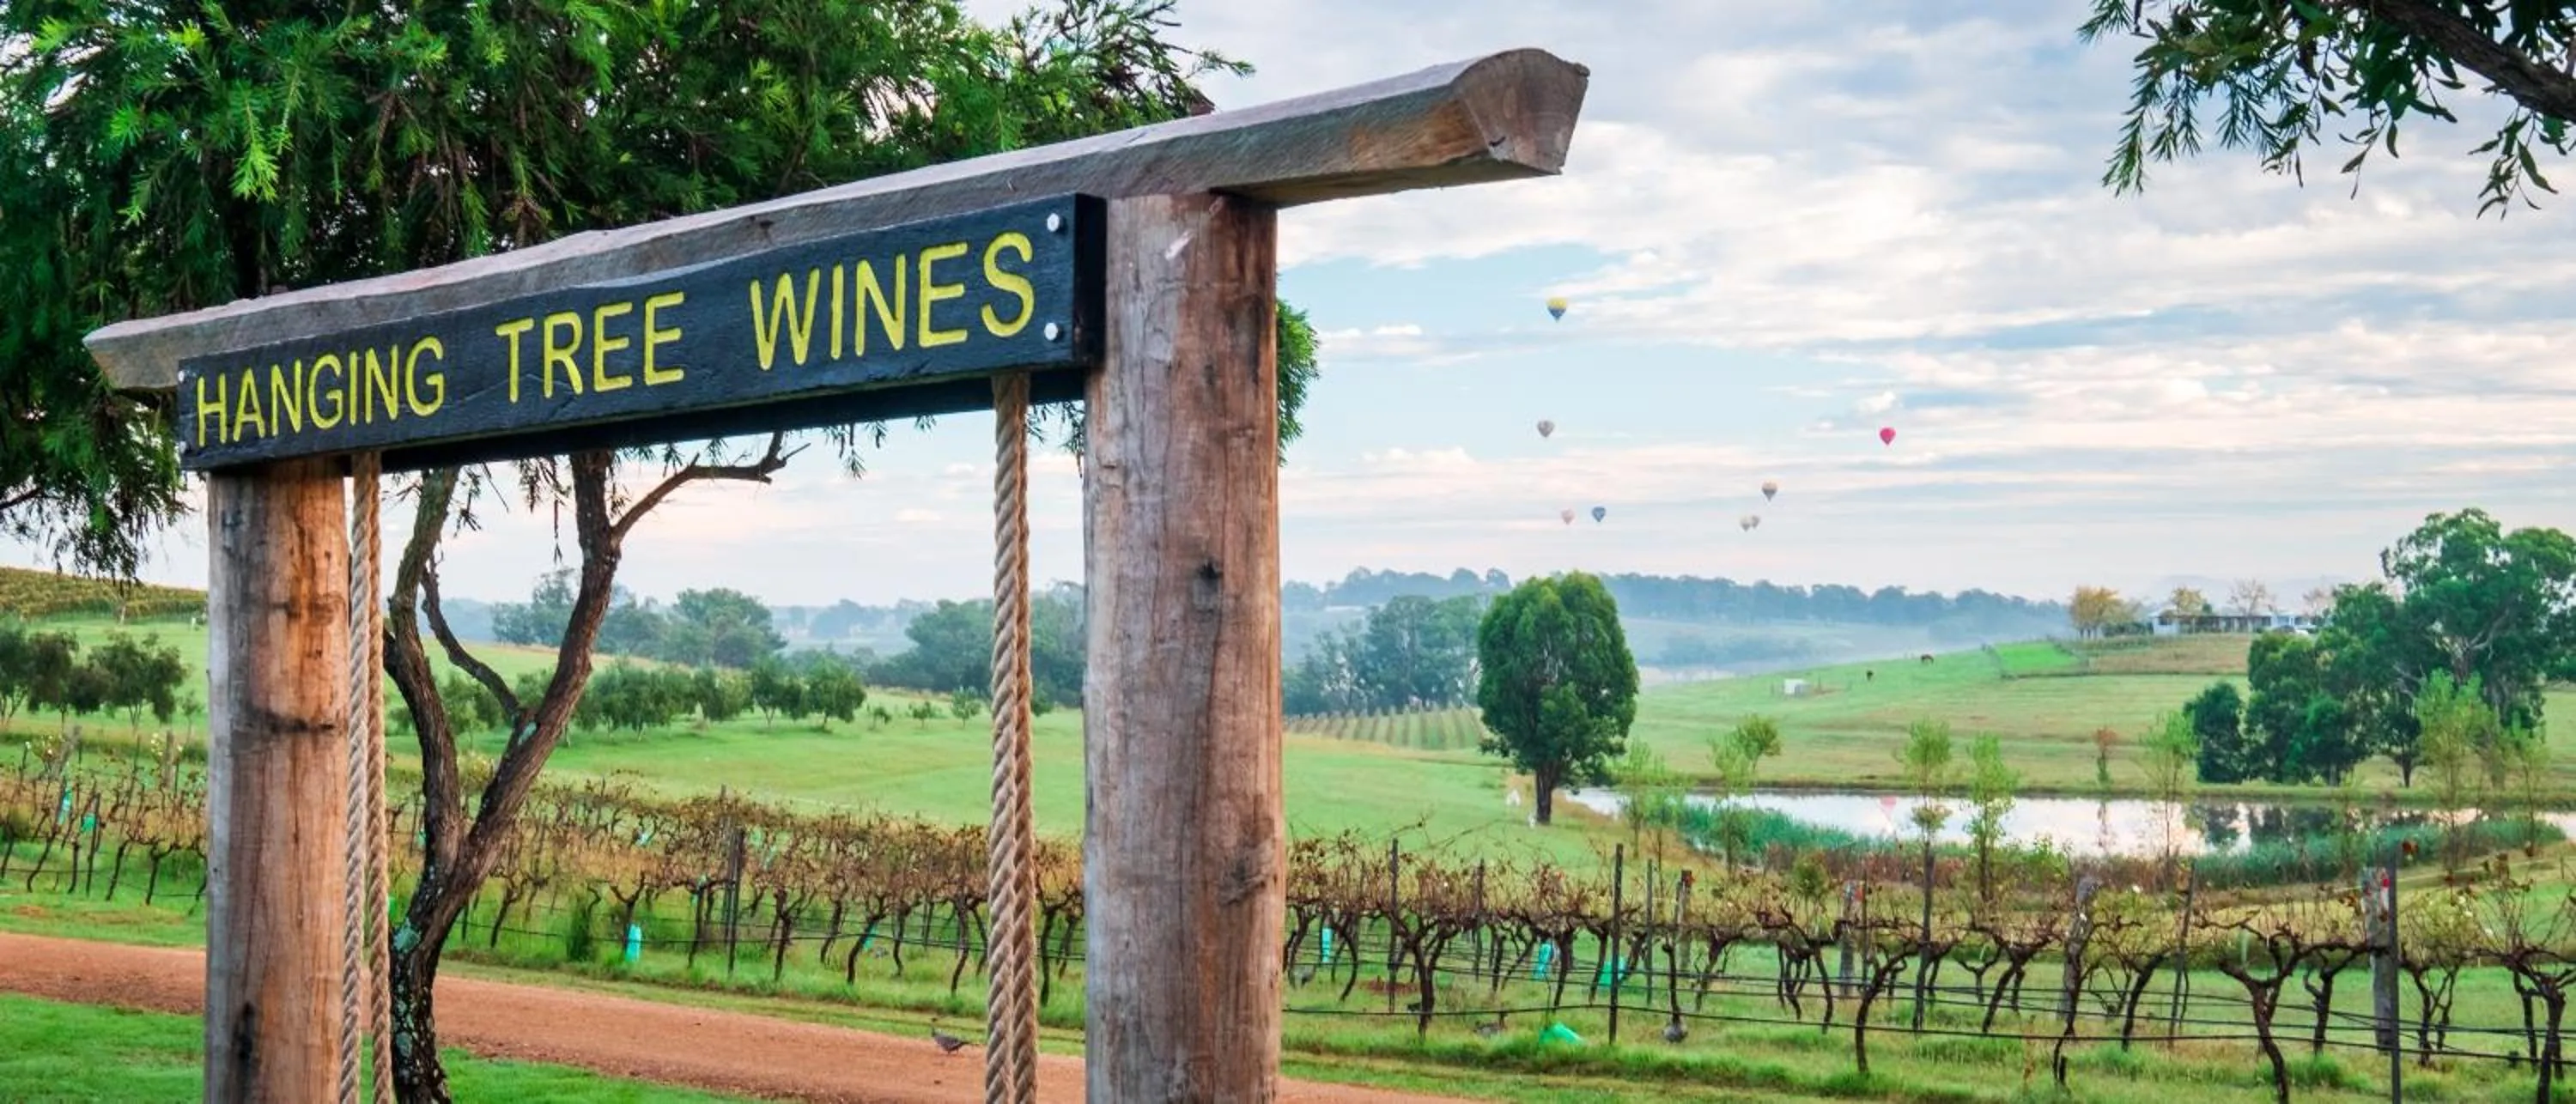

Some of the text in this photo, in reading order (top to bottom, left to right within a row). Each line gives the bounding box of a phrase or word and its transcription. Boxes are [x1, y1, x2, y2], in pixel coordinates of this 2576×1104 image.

[197, 233, 1035, 448] HANGING TREE WINES
